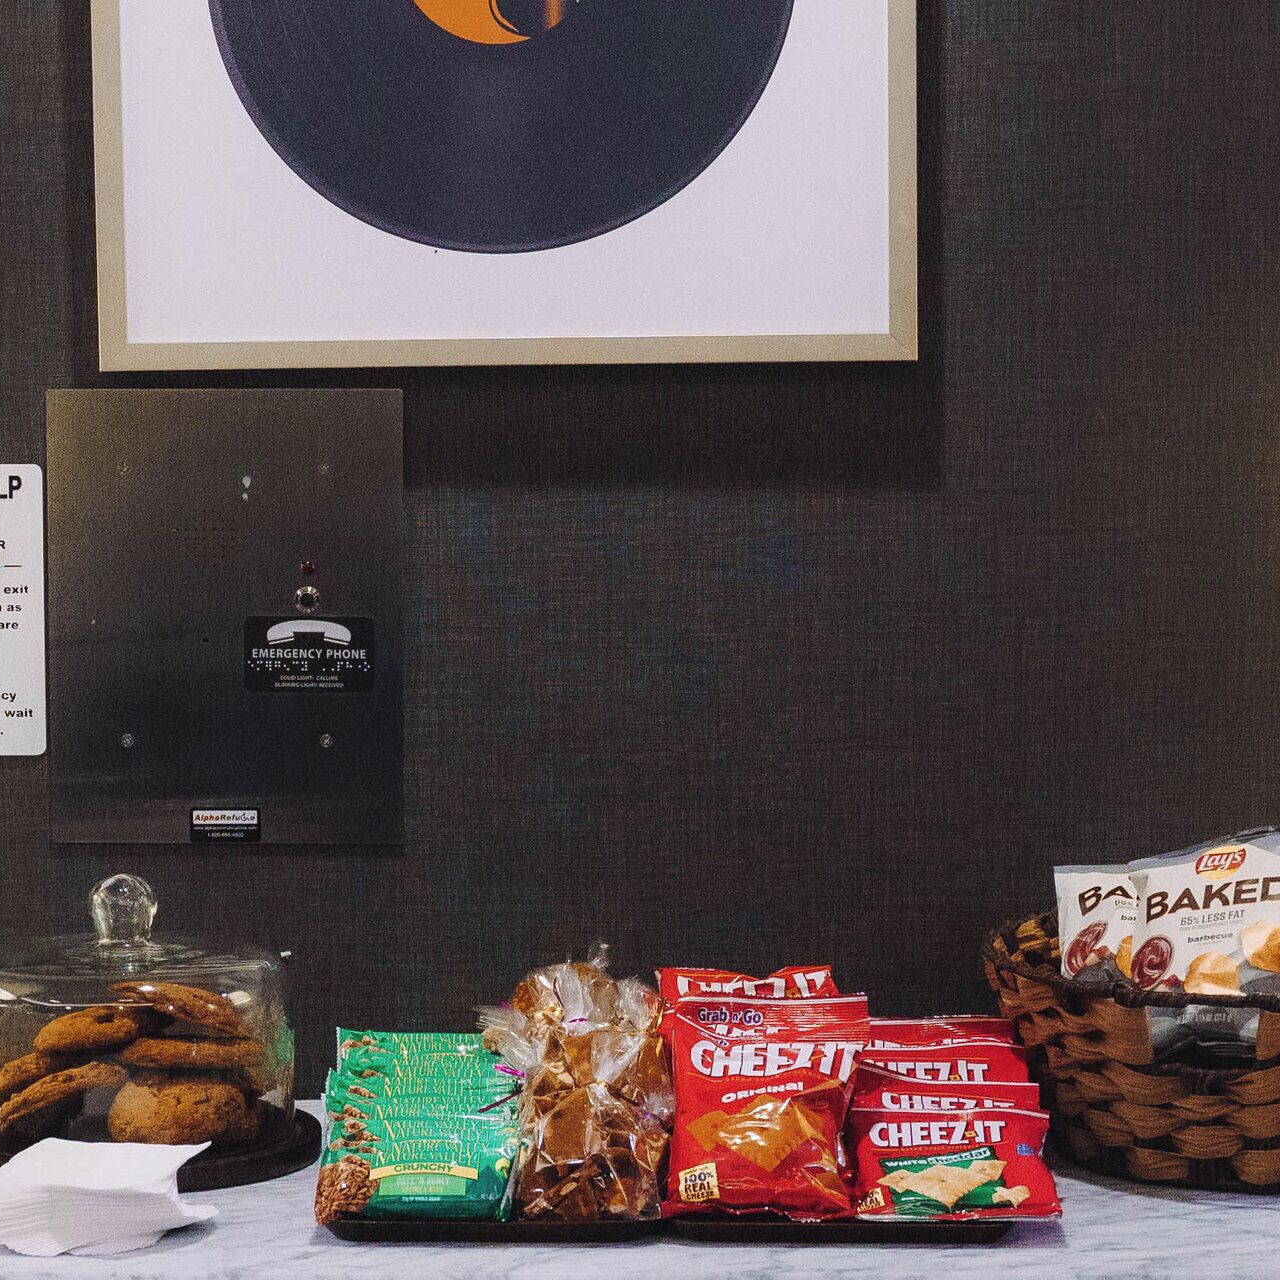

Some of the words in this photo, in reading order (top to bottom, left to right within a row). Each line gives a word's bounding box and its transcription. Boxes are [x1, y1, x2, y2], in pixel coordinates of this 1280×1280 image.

[3, 585, 29, 595] exit
[7, 604, 22, 612] as
[252, 648, 322, 659] EMERGENCY
[326, 649, 367, 660] PHONE
[4, 708, 33, 718] wait
[1197, 850, 1247, 875] Lay's
[1180, 916, 1200, 926] 65%
[1202, 912, 1226, 924] LESS
[1228, 910, 1246, 921] FAT
[1186, 931, 1234, 944] barbecue
[697, 1007, 728, 1023] Grab
[743, 1011, 762, 1024] Go
[372, 1151, 426, 1167] NATURE
[394, 1163, 453, 1173] CRUNCHY
[684, 1171, 714, 1184] 100%
[684, 1182, 713, 1194] REAL
[686, 1190, 715, 1200] CHEESE
